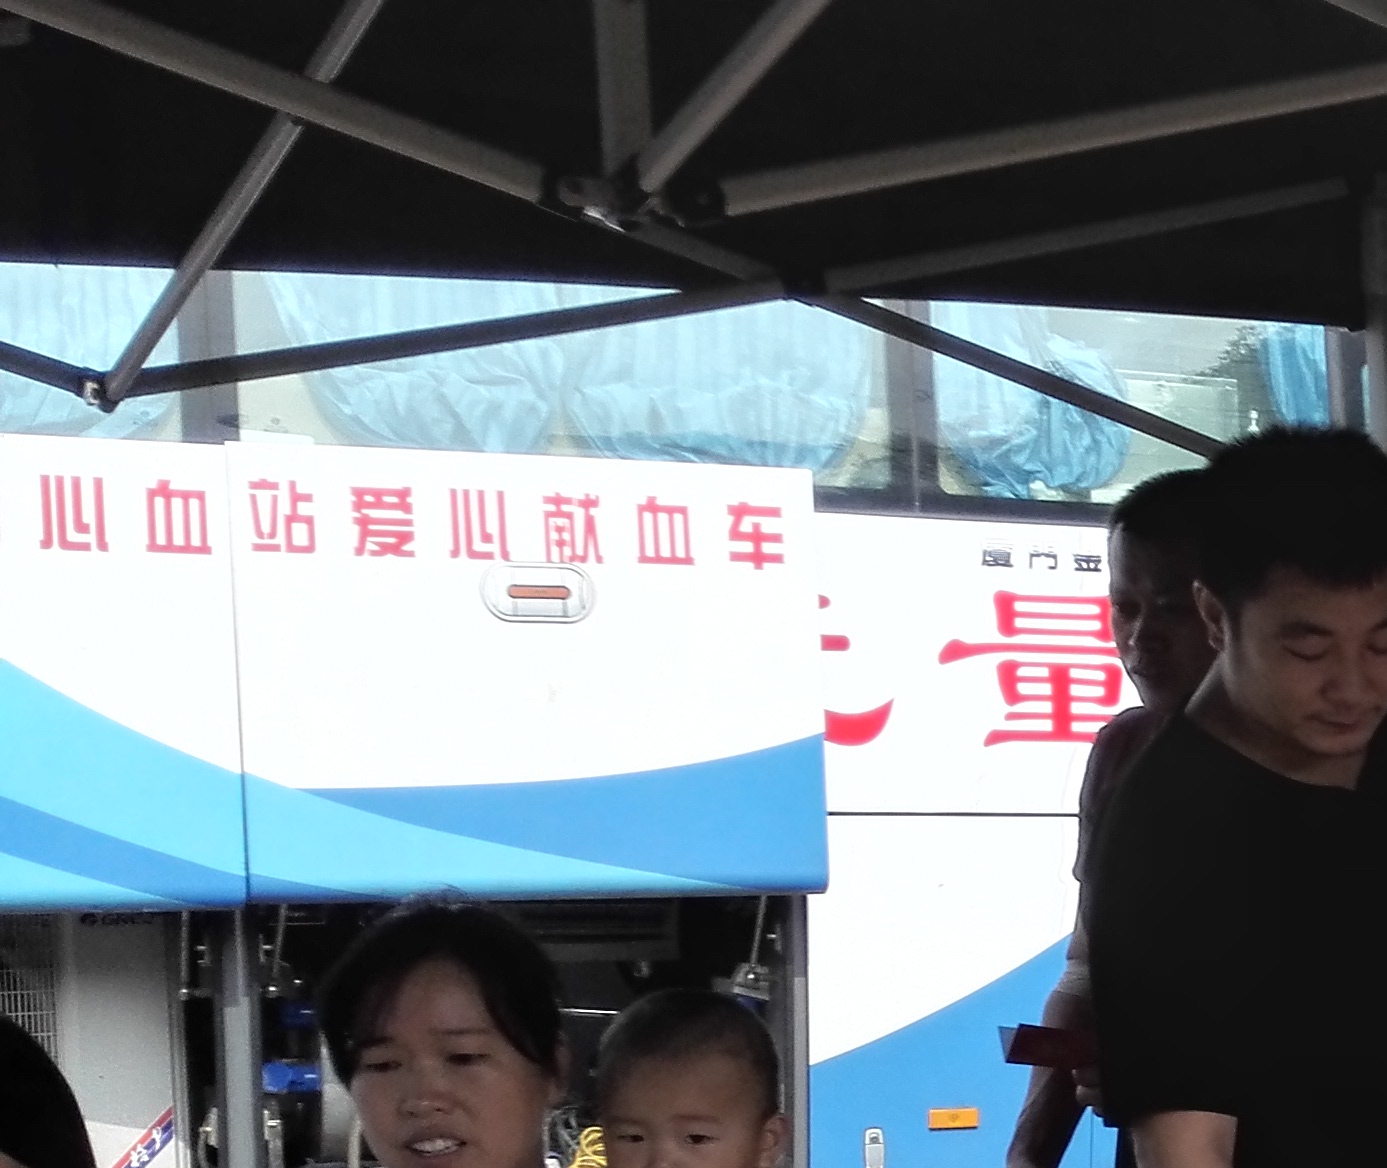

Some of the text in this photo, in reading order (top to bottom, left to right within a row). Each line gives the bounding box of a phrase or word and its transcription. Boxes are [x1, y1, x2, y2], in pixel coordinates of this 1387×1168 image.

[38, 473, 785, 571] 心血站爱心献血车
